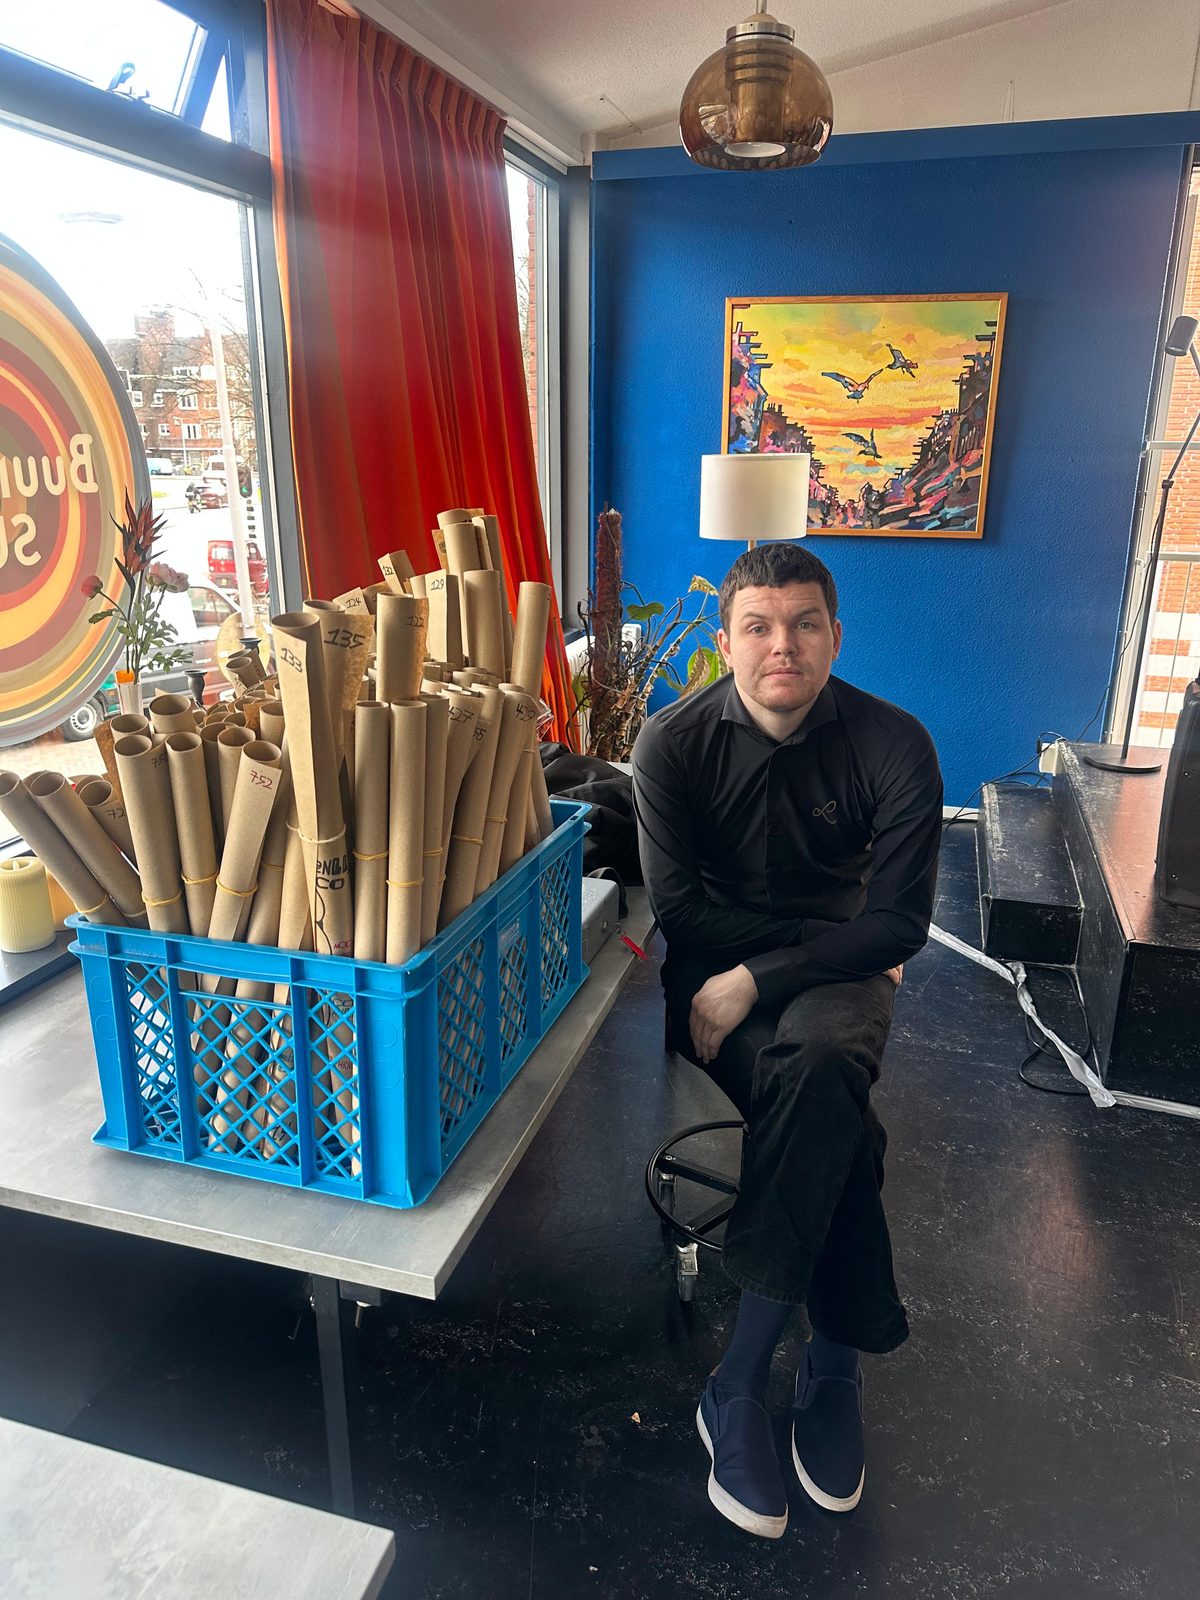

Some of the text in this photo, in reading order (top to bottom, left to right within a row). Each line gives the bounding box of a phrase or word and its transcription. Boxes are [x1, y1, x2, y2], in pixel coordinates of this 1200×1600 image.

[430, 578, 445, 591] 129
[323, 629, 366, 650] 135
[280, 647, 303, 673] 133
[249, 769, 273, 790] 752
